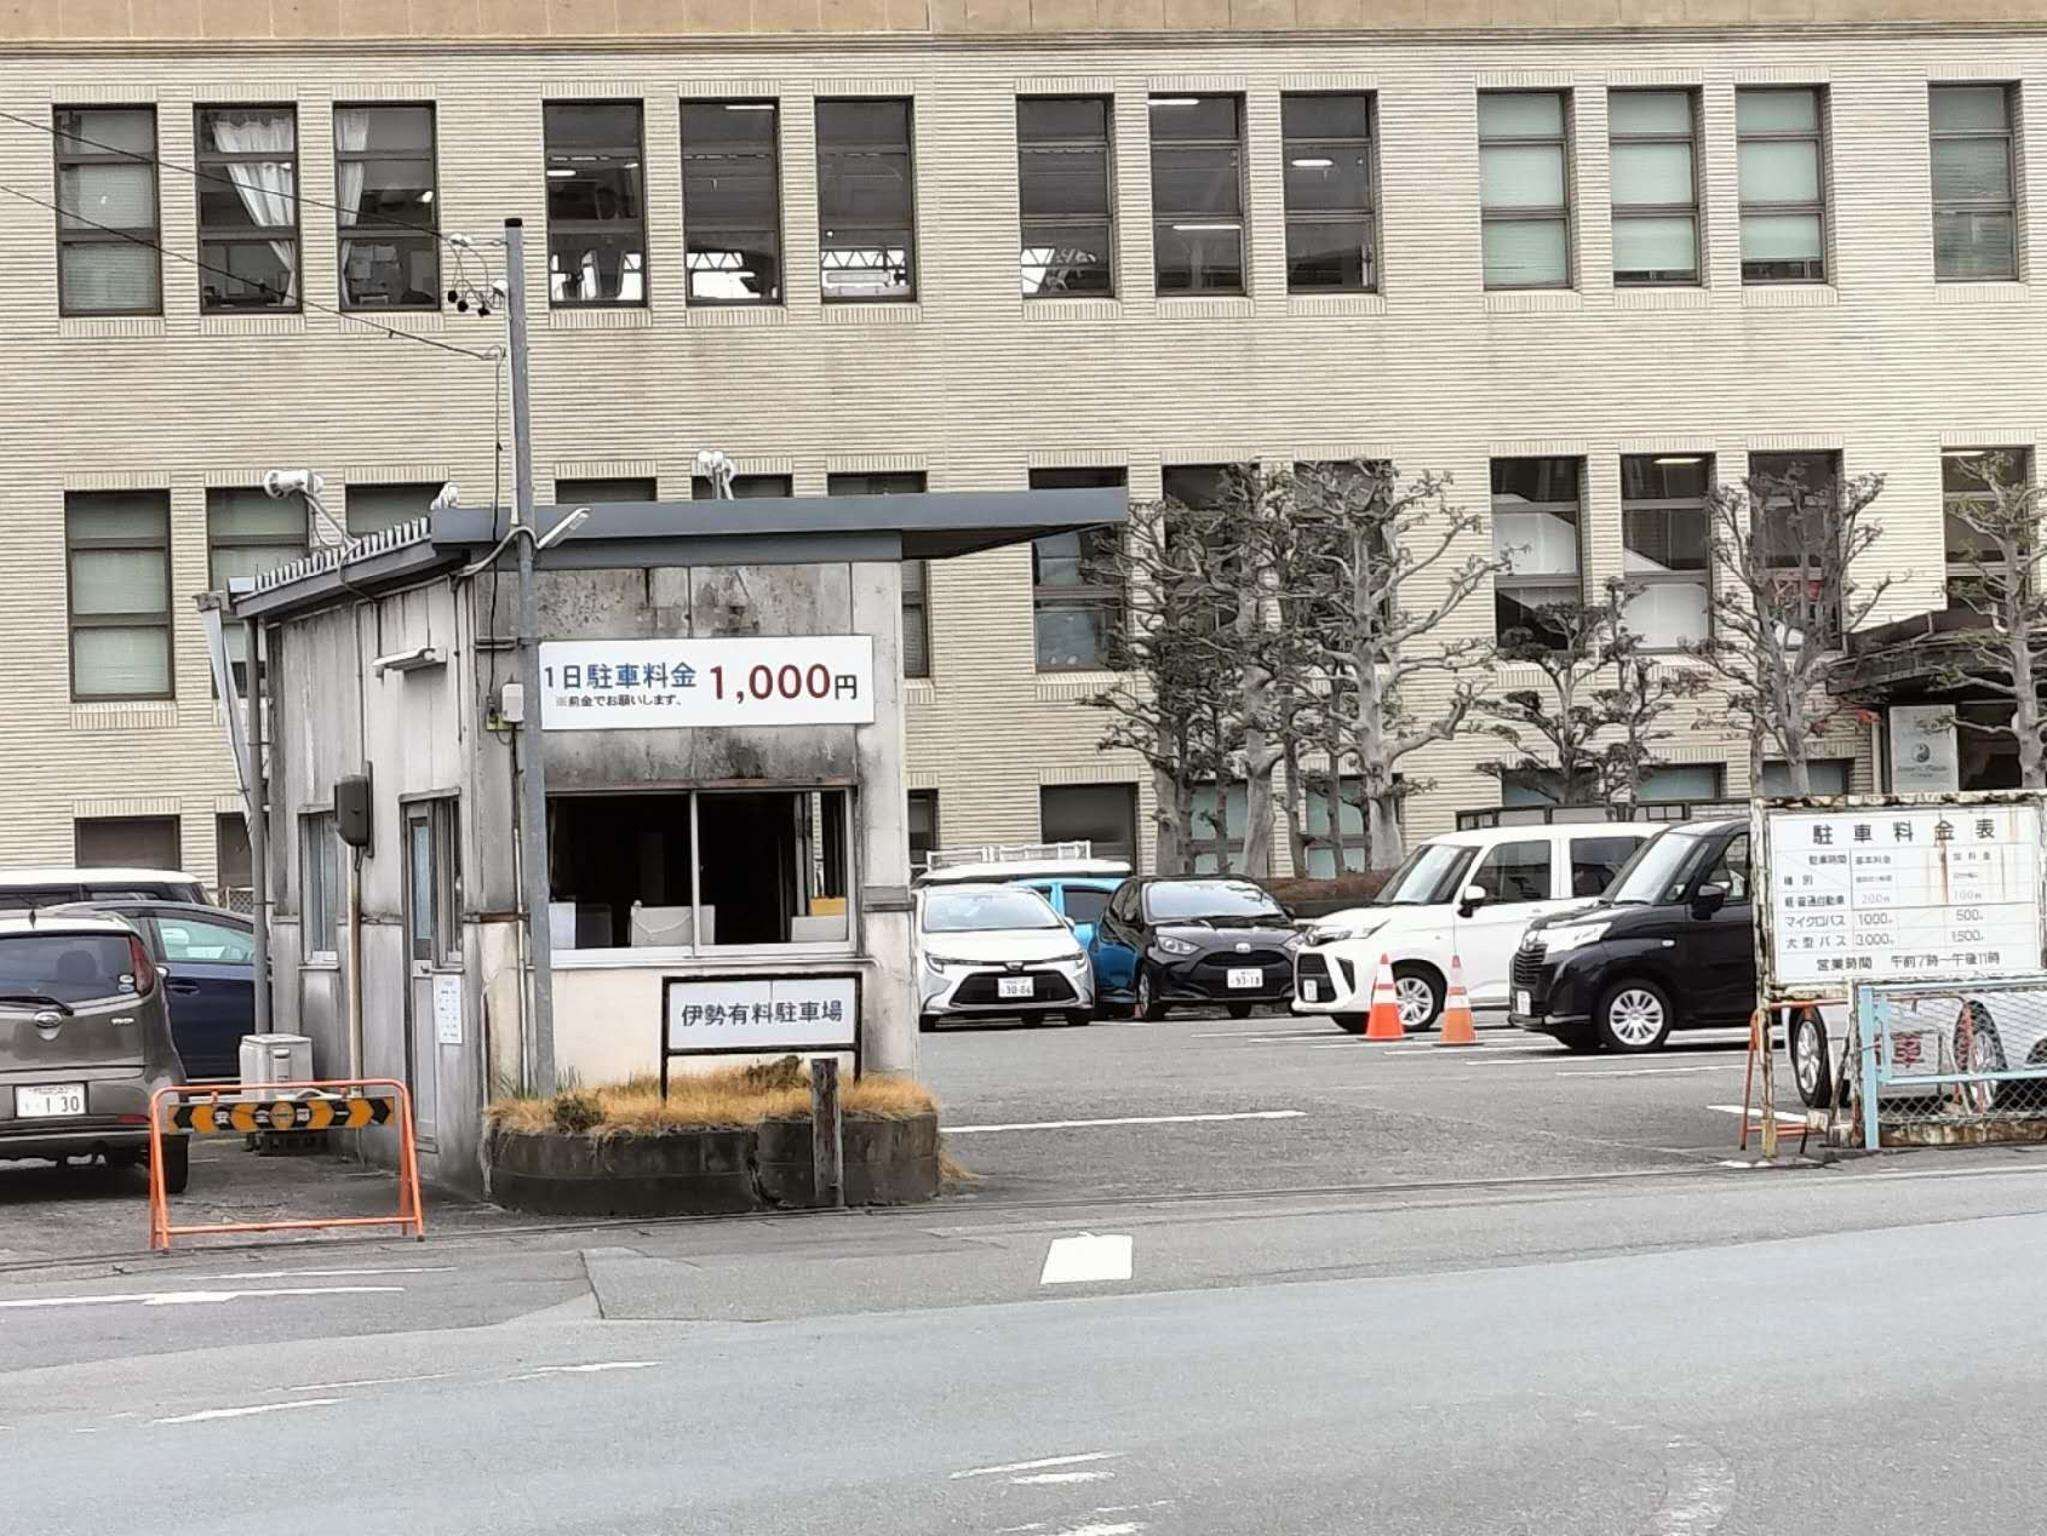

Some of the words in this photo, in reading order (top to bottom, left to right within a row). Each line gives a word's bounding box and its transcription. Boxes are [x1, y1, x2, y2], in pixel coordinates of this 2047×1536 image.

[544, 661, 697, 689] 1日駐車料金
[709, 663, 858, 704] 1,000円
[1813, 819, 1995, 846] 駐車料金表
[1785, 914, 1846, 928] マイクロバス
[1787, 935, 1847, 950] 大型バス
[1817, 956, 1873, 972] 営業時間
[681, 999, 843, 1027] 伊勢有料駐車場
